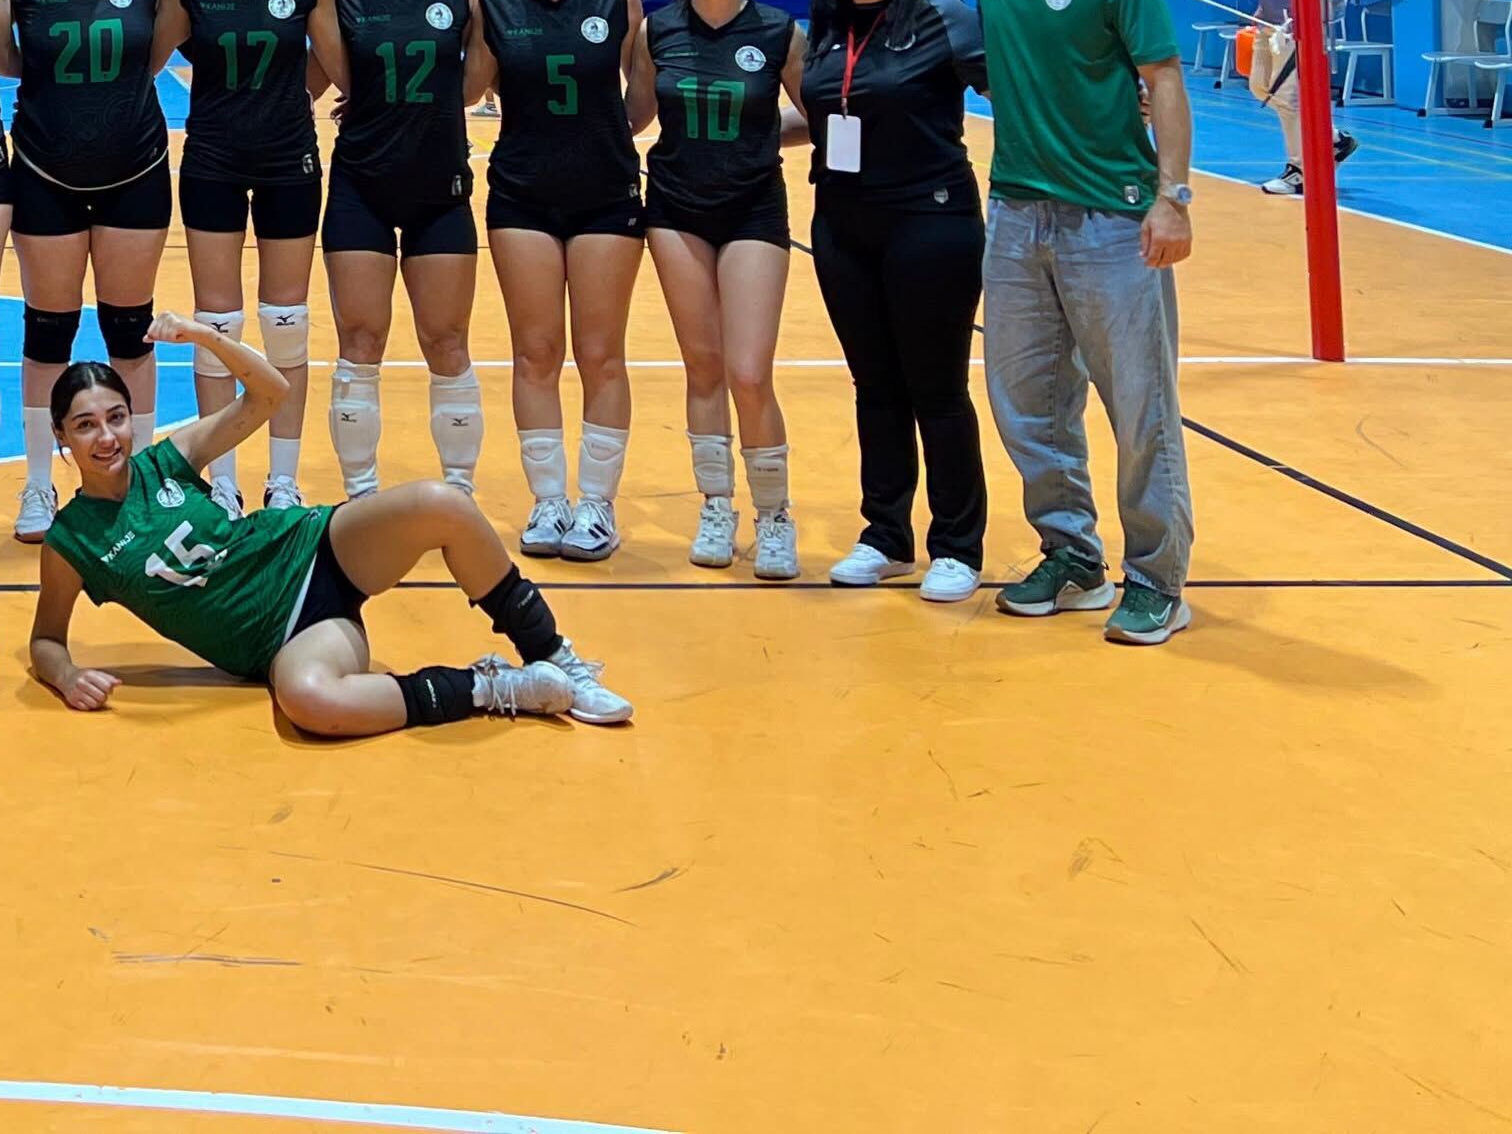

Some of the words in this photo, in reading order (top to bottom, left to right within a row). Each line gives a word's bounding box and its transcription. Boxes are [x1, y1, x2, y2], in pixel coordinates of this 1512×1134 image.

[48, 18, 124, 84] 20
[217, 31, 278, 90] 17
[376, 41, 436, 103] 12
[545, 54, 578, 115] 5
[676, 77, 745, 141] 10
[145, 520, 228, 587] 15
